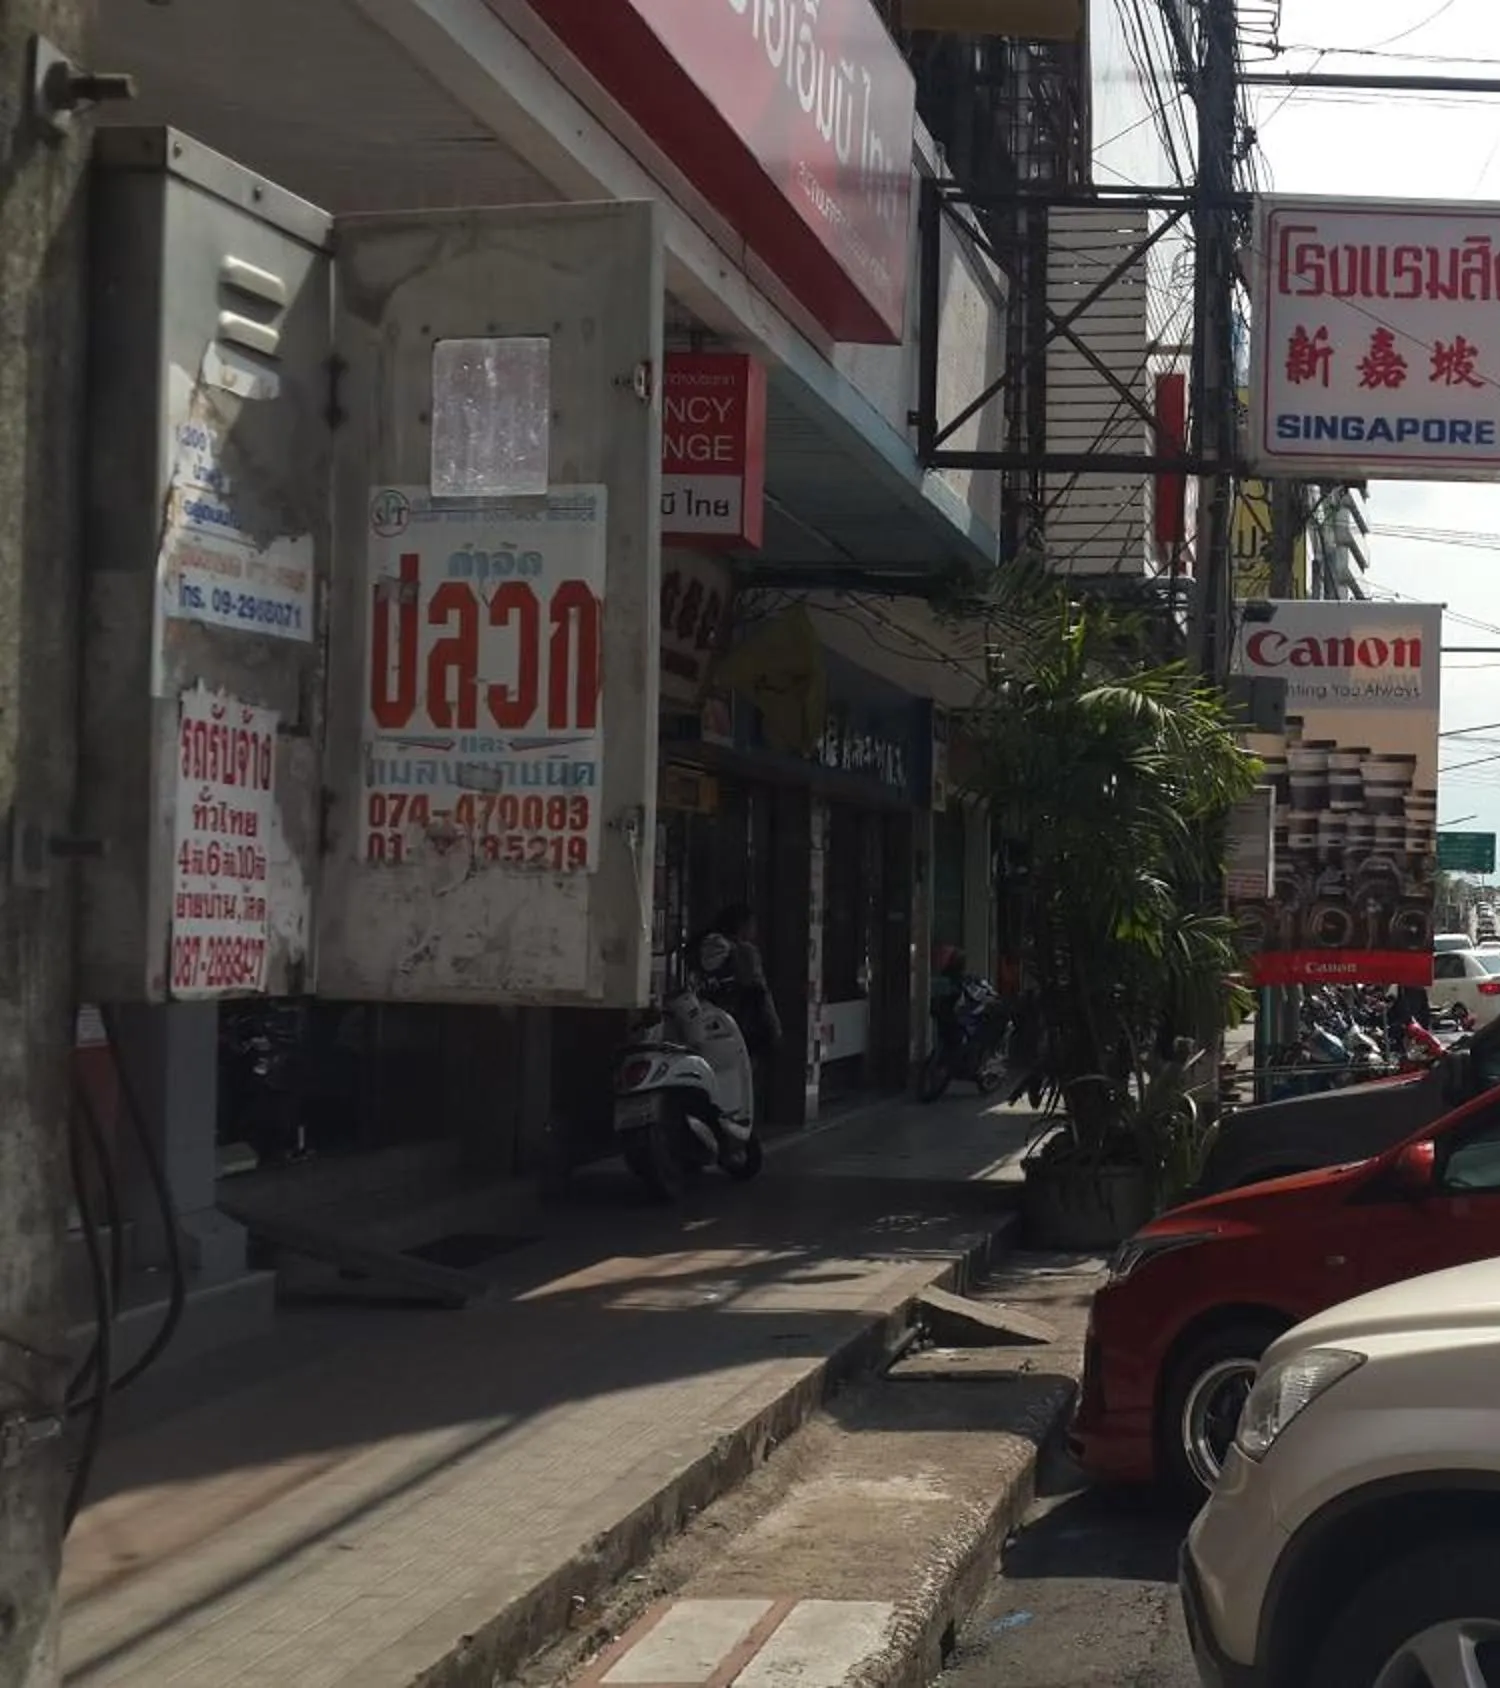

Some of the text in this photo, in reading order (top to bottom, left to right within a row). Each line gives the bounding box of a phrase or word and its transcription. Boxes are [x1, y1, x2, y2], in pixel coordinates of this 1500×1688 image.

[663, 396, 734, 424] NCY
[1276, 414, 1494, 445] SINGAPORE
[662, 434, 735, 462] NGE
[371, 553, 598, 730] ปลวก
[1247, 630, 1422, 668] Canon
[368, 792, 589, 831] 074-470083
